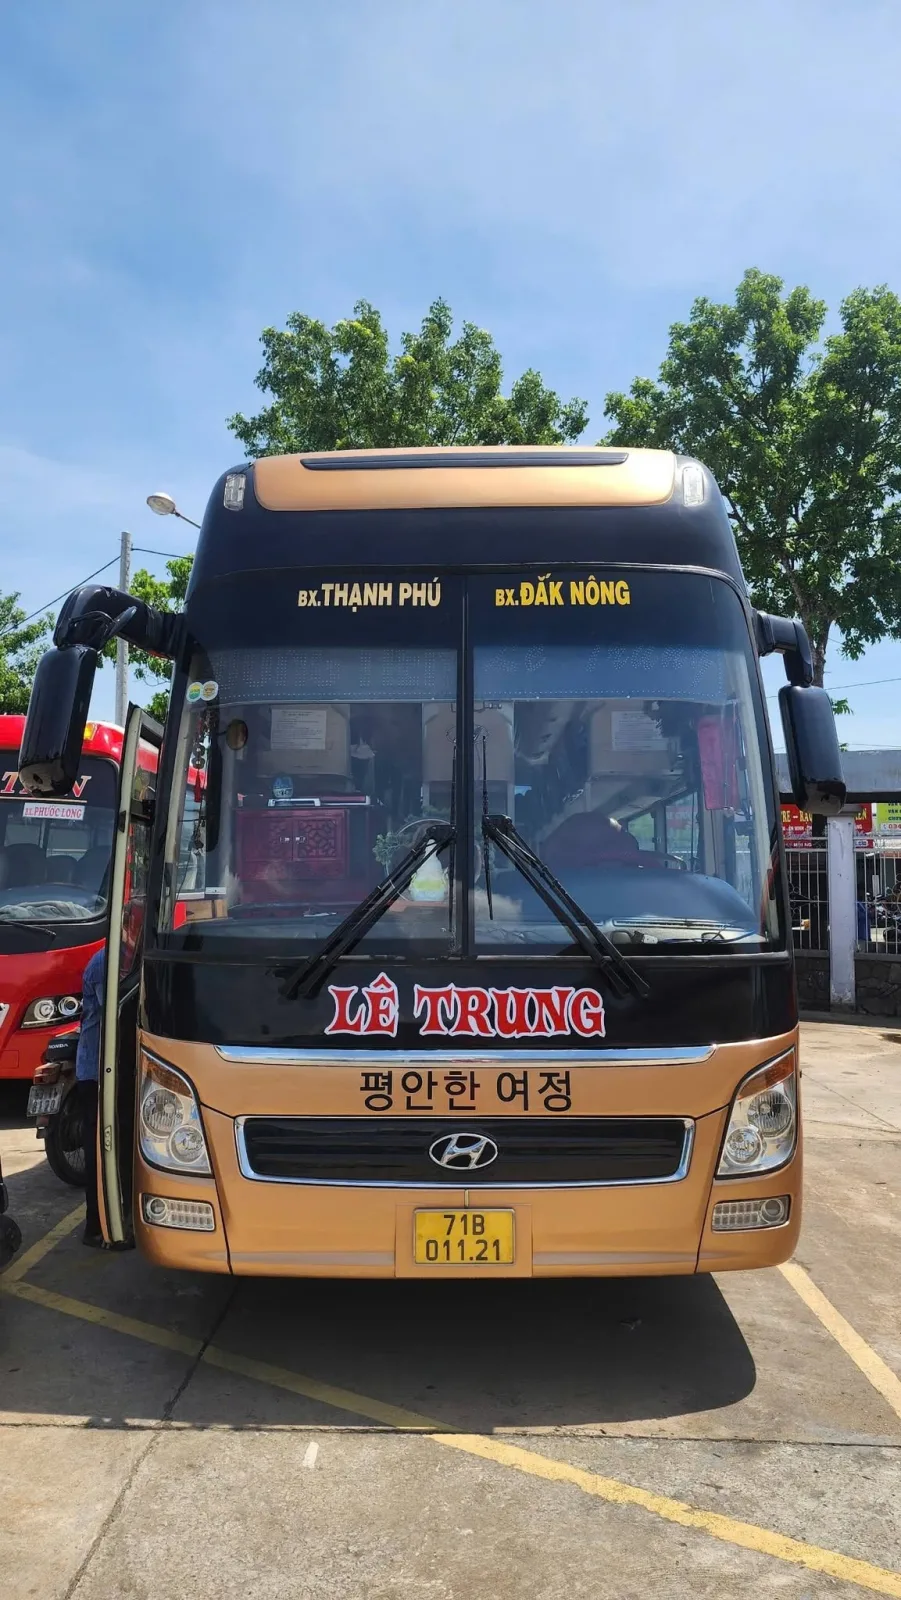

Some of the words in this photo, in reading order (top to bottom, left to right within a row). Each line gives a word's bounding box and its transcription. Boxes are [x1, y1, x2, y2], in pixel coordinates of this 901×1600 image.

[297, 582, 393, 613] BX.THẠNH
[399, 577, 442, 607] PHÚ
[495, 573, 565, 607] BX.ĐẮK
[570, 575, 631, 606] NÔNG
[324, 971, 400, 1038] LÊ
[413, 982, 606, 1039] TRUNG
[359, 1070, 481, 1112] 평안한
[496, 1070, 573, 1112] 여정
[443, 1213, 485, 1236] 71B
[425, 1239, 501, 1262] 011.21
